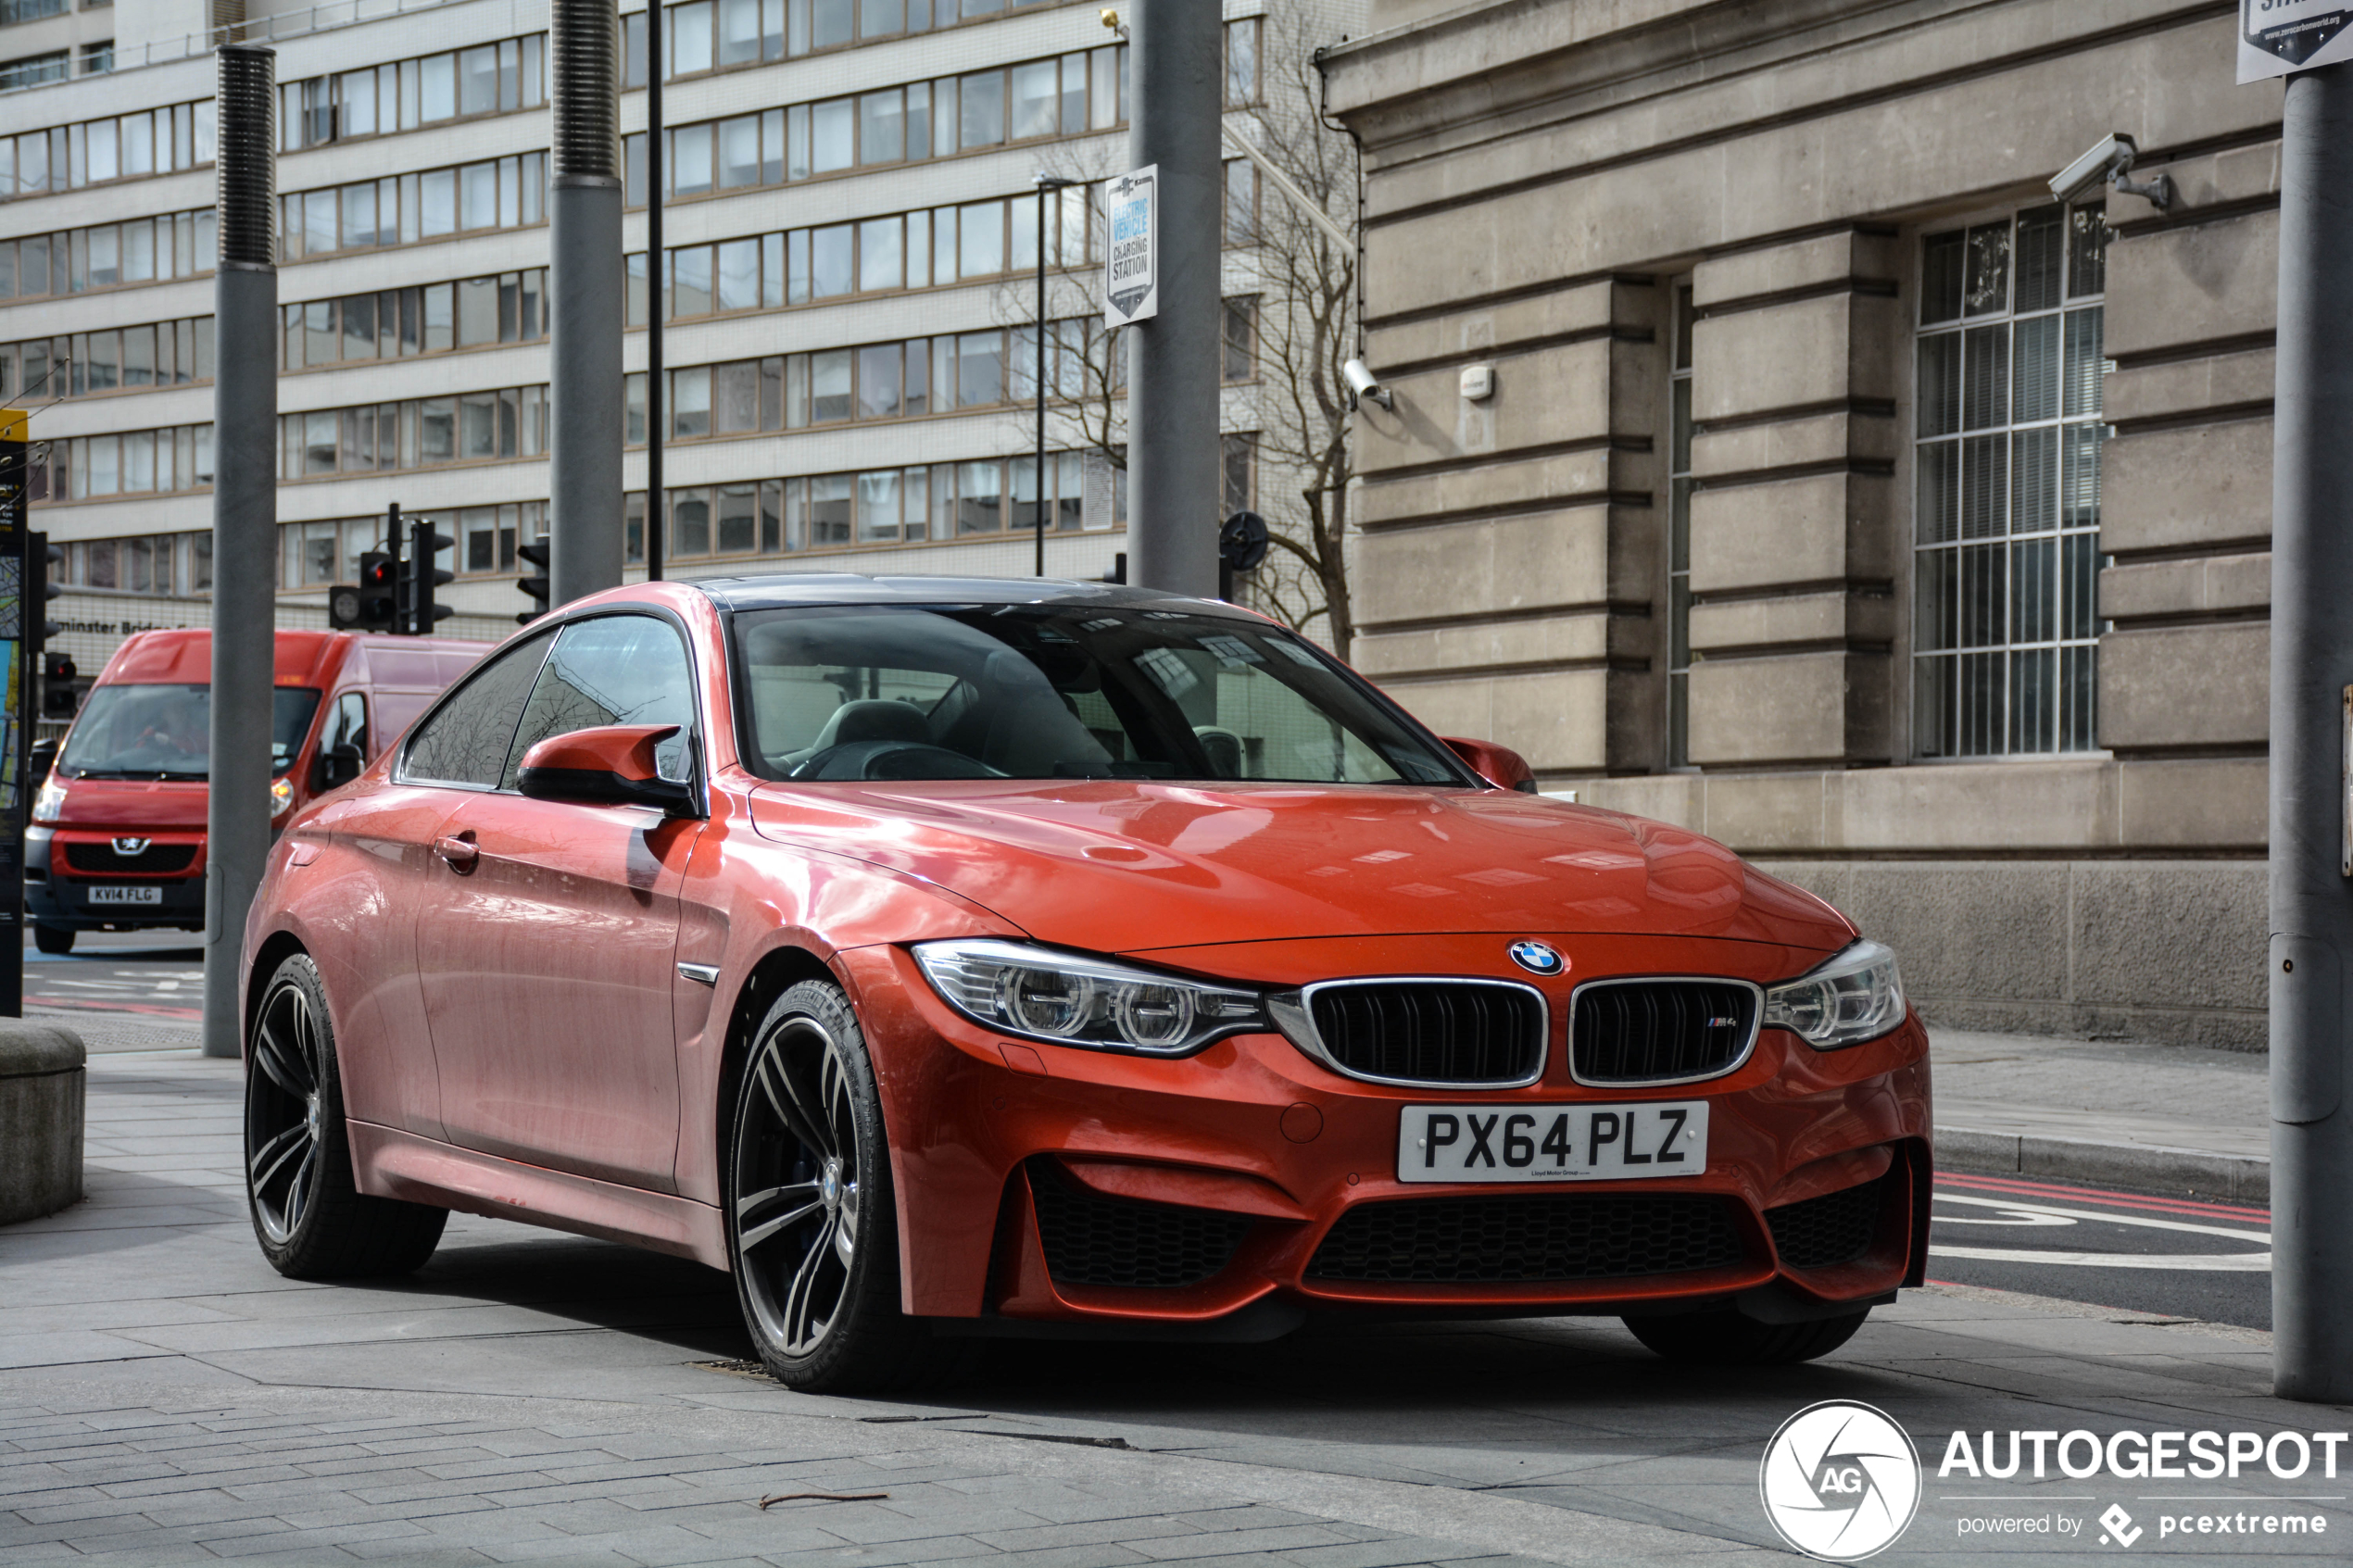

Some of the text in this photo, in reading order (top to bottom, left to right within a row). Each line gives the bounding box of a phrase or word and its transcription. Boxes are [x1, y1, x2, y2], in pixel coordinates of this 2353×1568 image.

[2264, 16, 2340, 40] www.zerocarbonworld.org
[1114, 197, 1148, 223] ELECTRIC
[1114, 214, 1148, 242] VEHICLE
[1114, 237, 1148, 261] CHARGING
[1114, 254, 1148, 281] STATION
[51, 618, 171, 634] minster Brid
[95, 889, 152, 901] KV14 FLG
[1716, 1018, 1736, 1026] M4
[1425, 1110, 1688, 1168] PX64 PLZ
